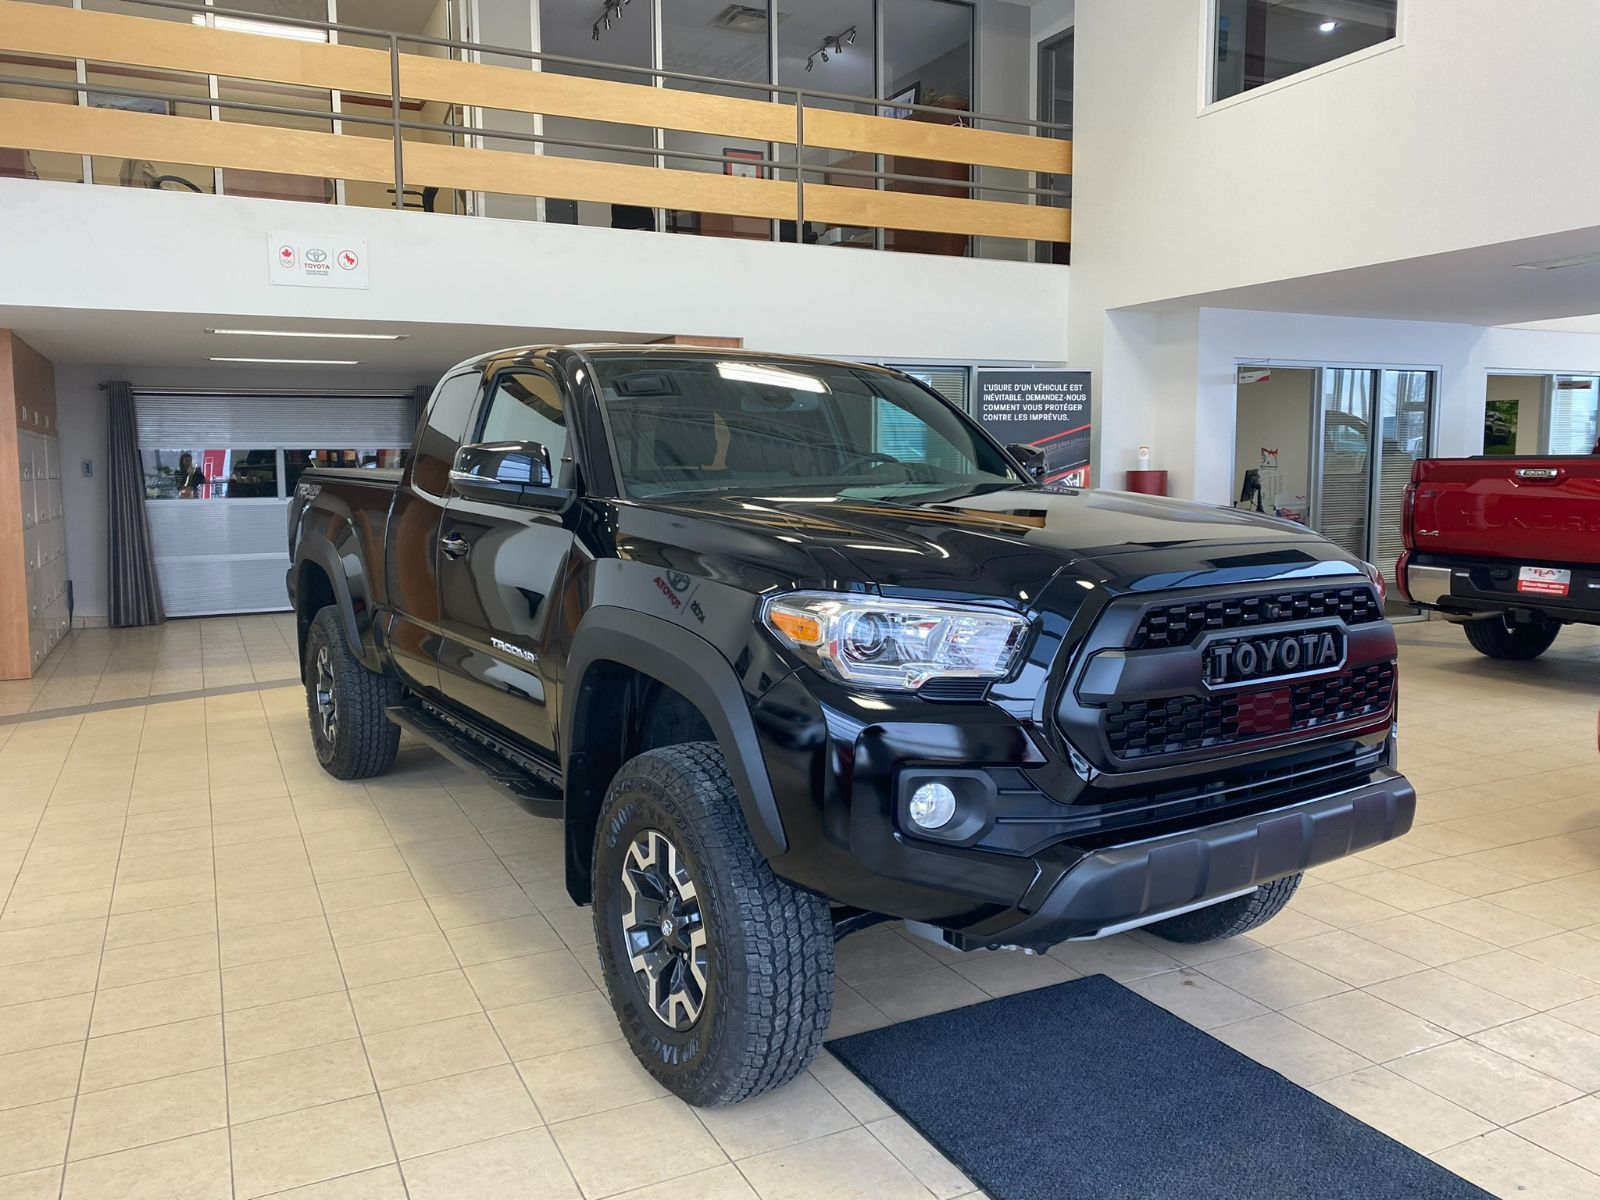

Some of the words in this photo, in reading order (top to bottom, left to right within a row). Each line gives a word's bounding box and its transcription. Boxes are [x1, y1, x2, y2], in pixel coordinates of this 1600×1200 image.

[1033, 383, 1067, 391] VÉHICULE
[983, 393, 1024, 401] INÉVITABLE.
[1045, 403, 1083, 411] PROTÉGER
[983, 413, 1012, 421] CONTRE
[1014, 413, 1028, 421] LES
[1029, 412, 1070, 421] IMPRÉVUS.
[490, 637, 538, 663] TACOMA
[1211, 632, 1337, 677] TOYOTA
